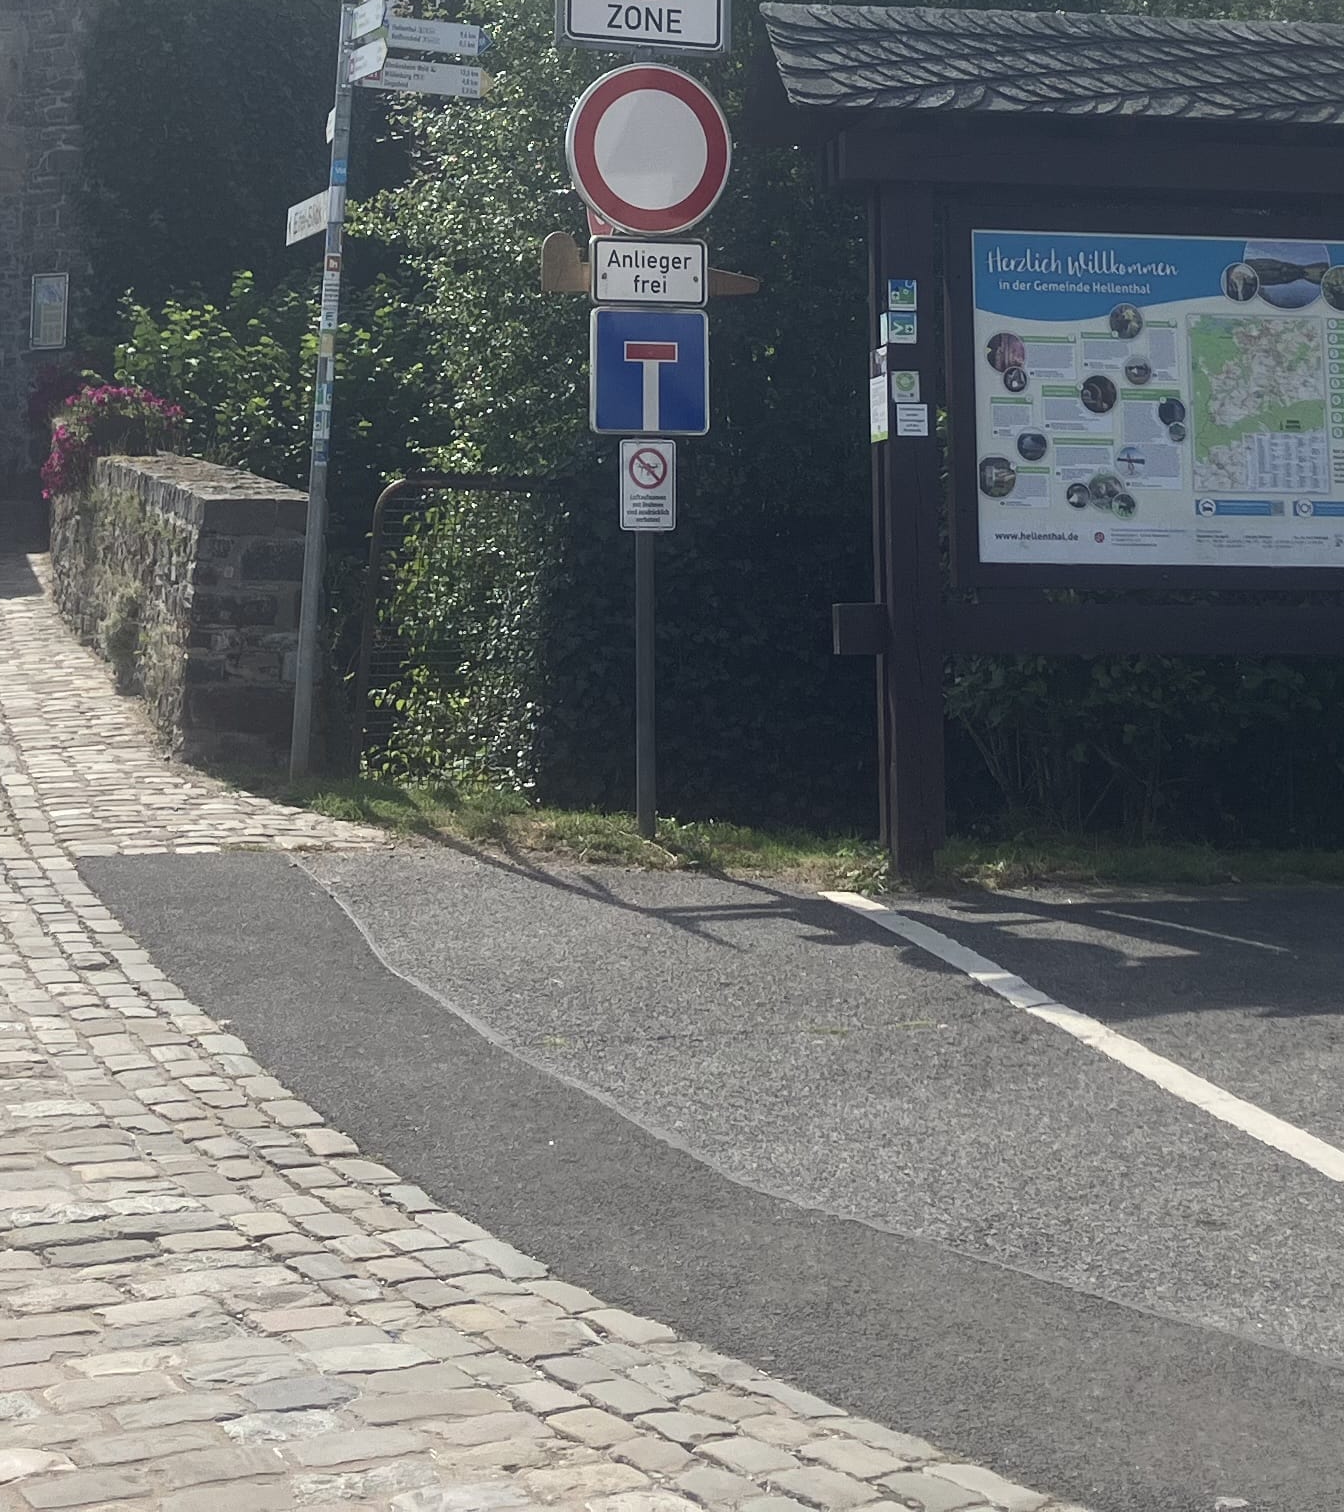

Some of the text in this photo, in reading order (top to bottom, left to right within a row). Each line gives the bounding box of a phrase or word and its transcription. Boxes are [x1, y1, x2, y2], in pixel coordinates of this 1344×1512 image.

[606, 3, 683, 34] ZONE
[606, 250, 693, 274] Anlieger
[986, 246, 1179, 277] Herzlich Willkommen
[632, 274, 668, 294] frei
[999, 279, 1151, 294] in der Gemeinde Hellenthal
[995, 531, 1079, 542] www.hellenthal.de
